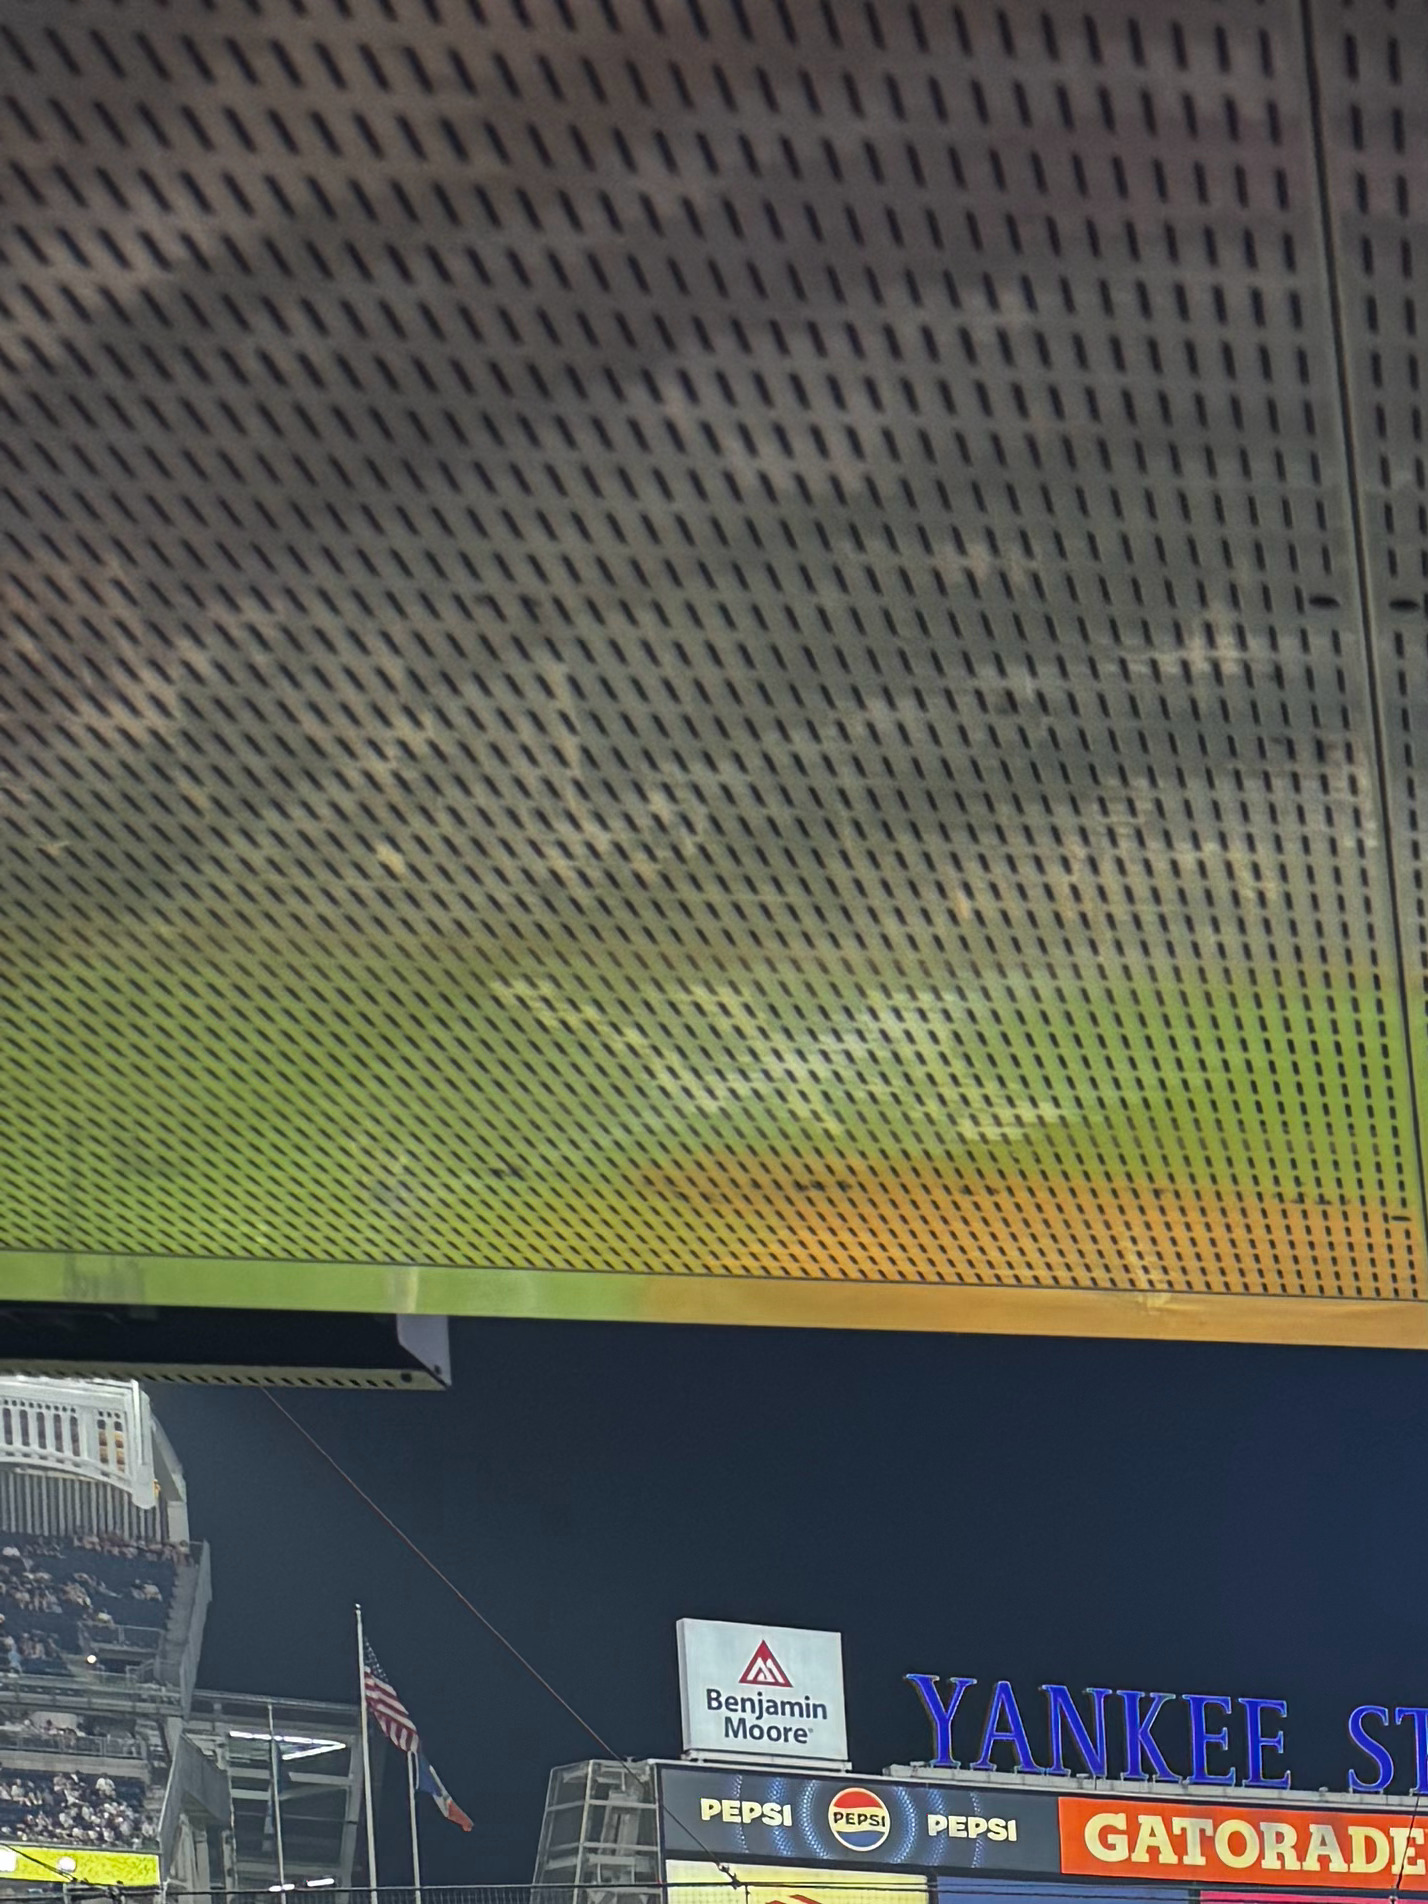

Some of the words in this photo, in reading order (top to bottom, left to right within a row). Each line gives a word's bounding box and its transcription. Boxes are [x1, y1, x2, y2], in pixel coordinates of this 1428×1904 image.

[706, 1689, 828, 1722] Benjamin
[724, 1717, 810, 1744] Moore
[906, 1673, 1291, 1789] YANKEE
[700, 1798, 793, 1826] PEPSI
[832, 1811, 886, 1828] PEPSI
[927, 1814, 1018, 1842] PEPSI
[1084, 1811, 1426, 1876] GATORADE
